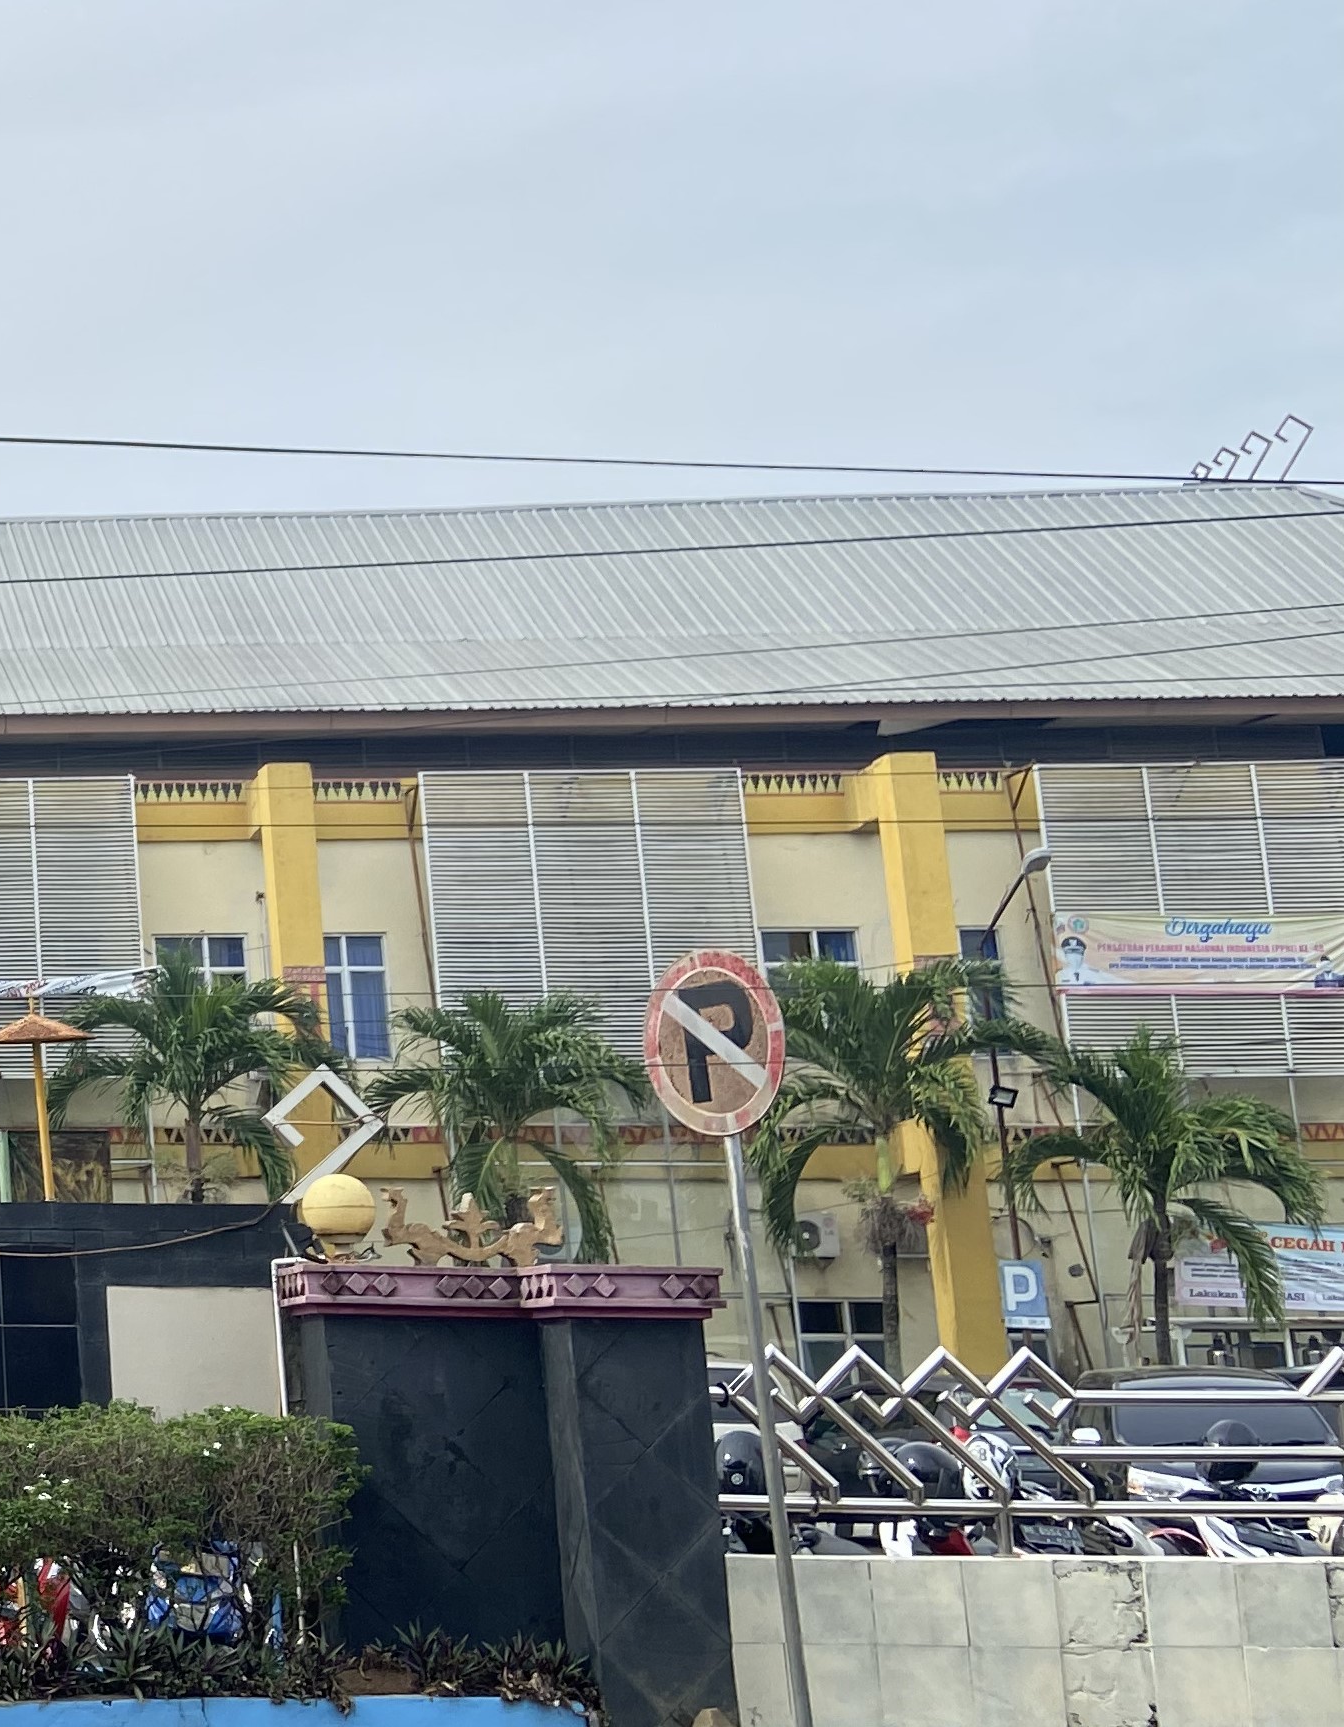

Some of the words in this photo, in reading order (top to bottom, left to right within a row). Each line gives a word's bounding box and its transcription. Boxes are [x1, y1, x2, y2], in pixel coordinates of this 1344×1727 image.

[1165, 917, 1273, 943] Dirgahayu
[1270, 1236, 1335, 1252] CEGAH
[1004, 1266, 1038, 1311] P
[1189, 1288, 1238, 1299] Lakukan
